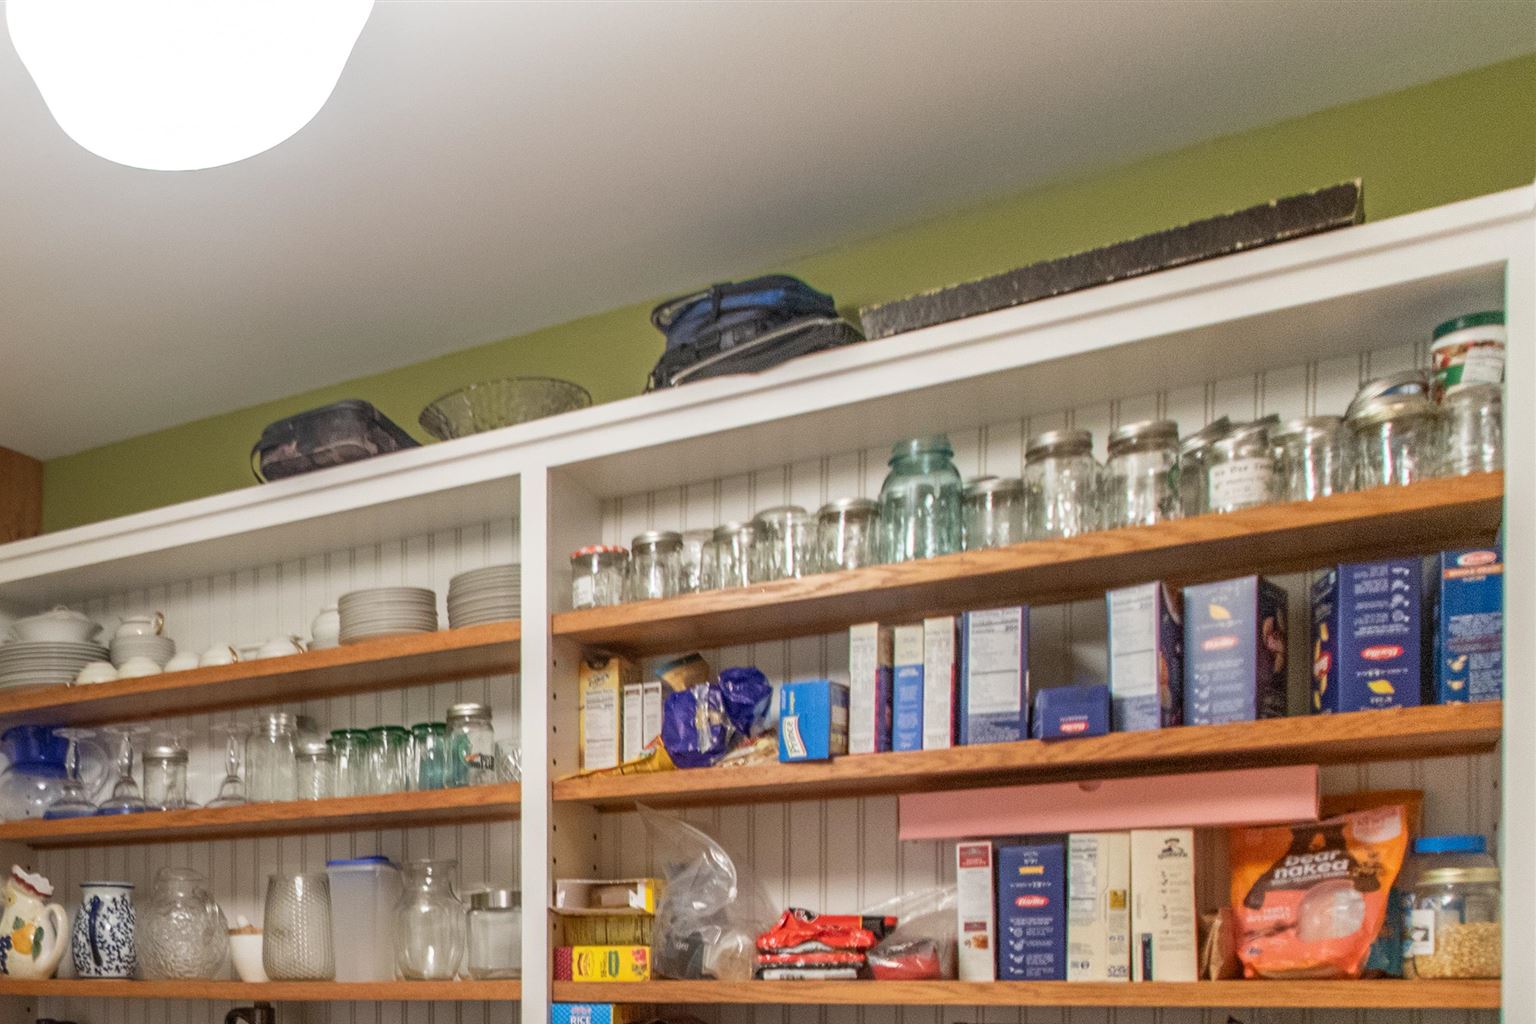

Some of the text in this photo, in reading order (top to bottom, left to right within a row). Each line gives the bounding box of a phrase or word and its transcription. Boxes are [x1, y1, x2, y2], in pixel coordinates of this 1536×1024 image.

[1284, 849, 1342, 868] bear
[1273, 858, 1350, 880] naked
[570, 1015, 592, 1024] RICE
